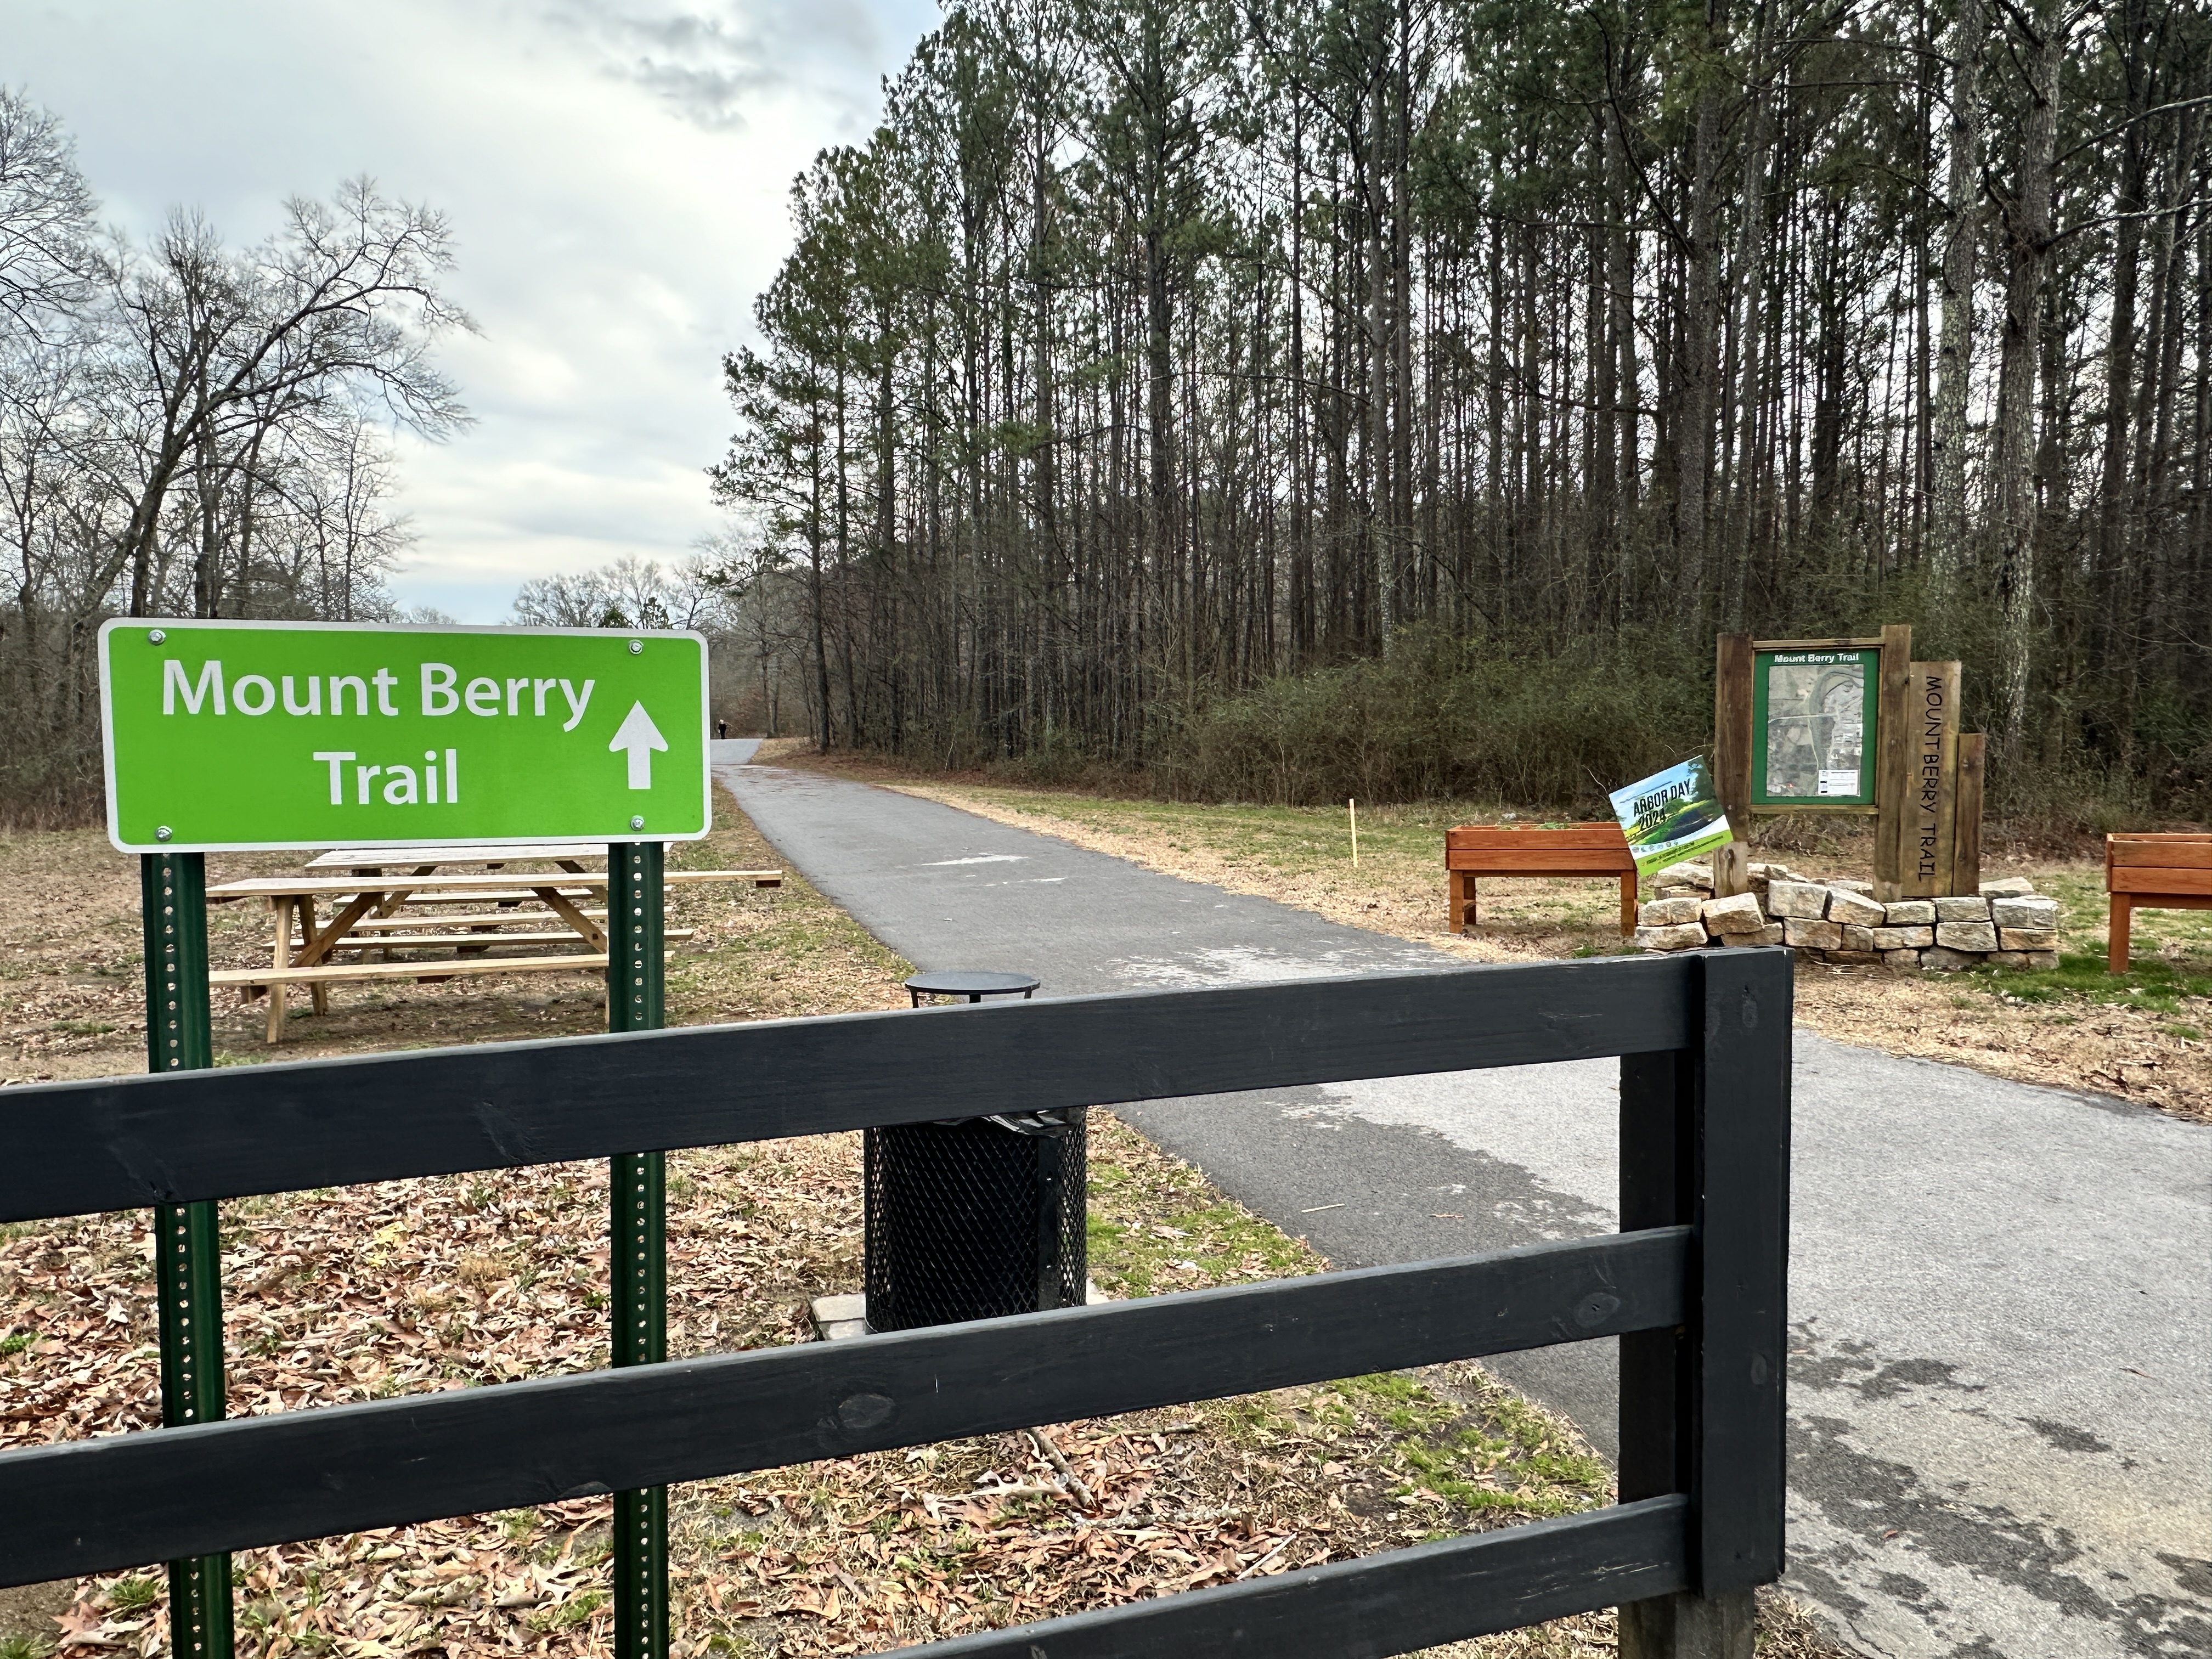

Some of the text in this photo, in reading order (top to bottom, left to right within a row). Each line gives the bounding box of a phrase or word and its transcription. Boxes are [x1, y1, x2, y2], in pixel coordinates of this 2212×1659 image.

[1774, 653, 1859, 663] Mount Berry Trail
[162, 659, 596, 733] Mount Berry
[313, 748, 459, 805] Trail
[1633, 789, 1668, 817] ARBOR
[1671, 778, 1691, 800] DAY
[1918, 676, 1942, 882] MOUNT BERRY TRAIL
[1639, 808, 1666, 831] 2024
